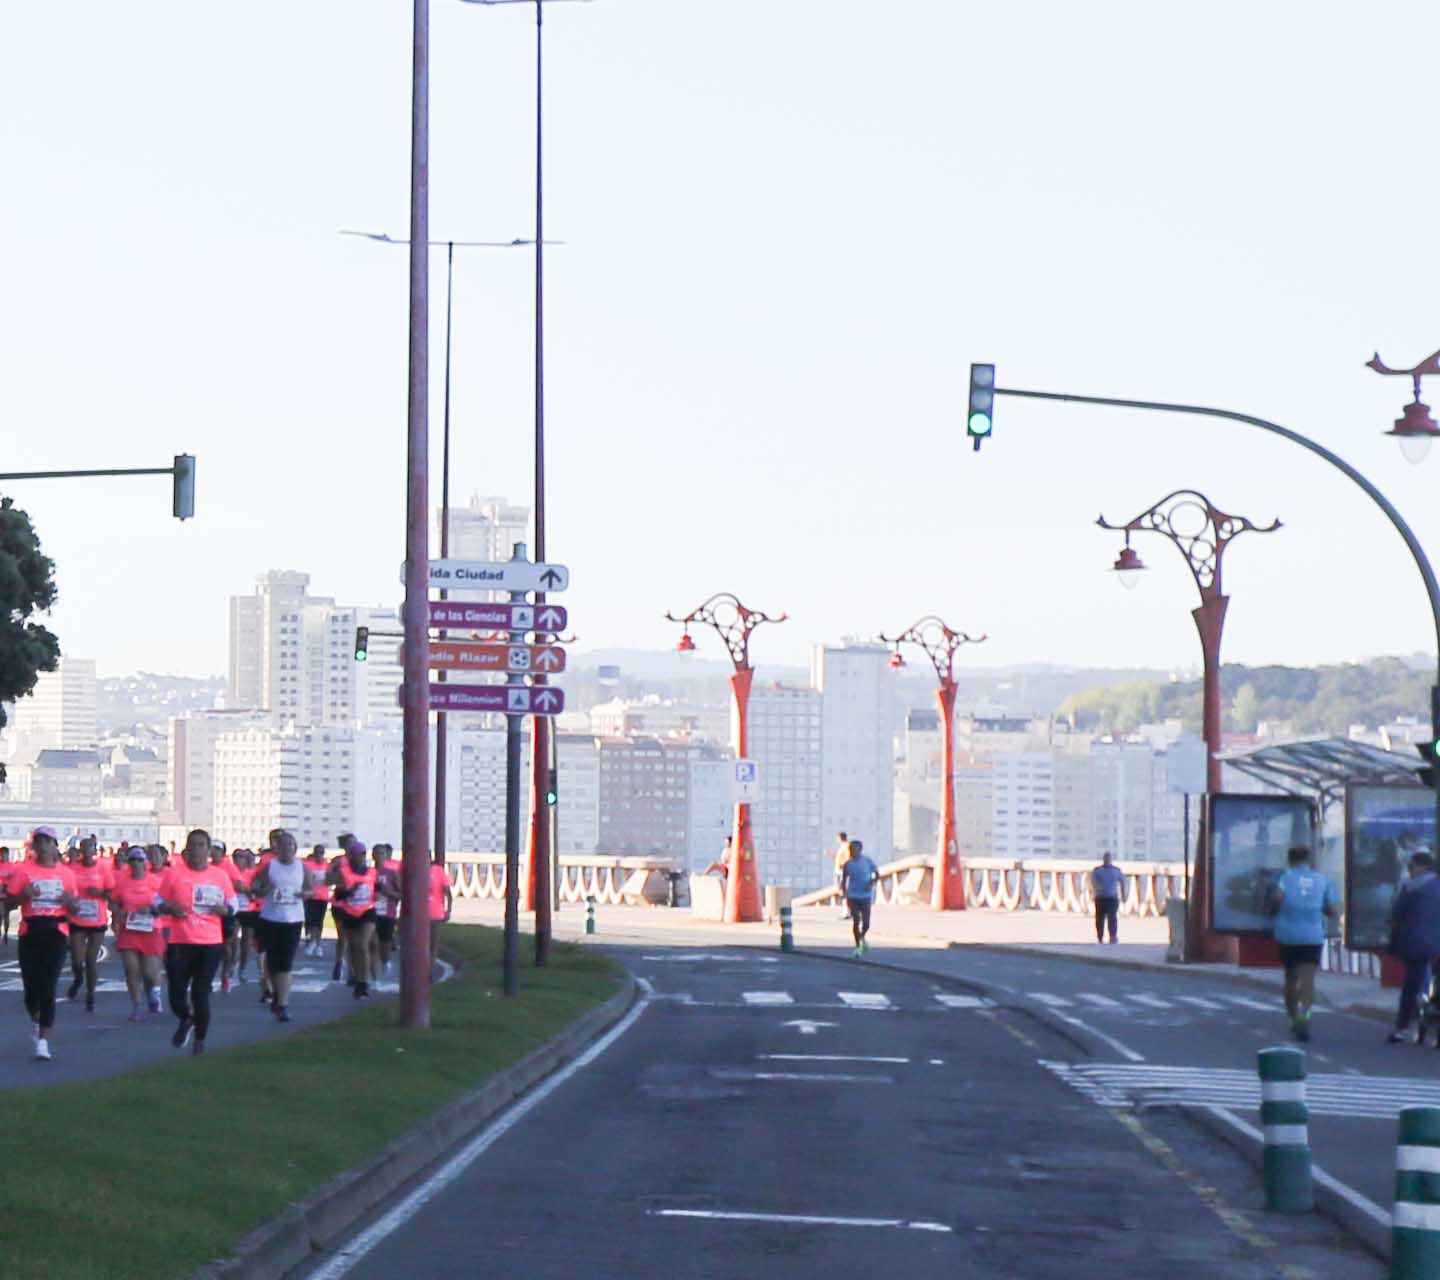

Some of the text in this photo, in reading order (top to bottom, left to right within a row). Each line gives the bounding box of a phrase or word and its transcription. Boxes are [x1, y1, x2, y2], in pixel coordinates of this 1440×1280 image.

[429, 568, 504, 580] ida Ciudad
[433, 610, 446, 621] de
[465, 610, 507, 622] Ciencias
[428, 651, 500, 664] adio Riazor
